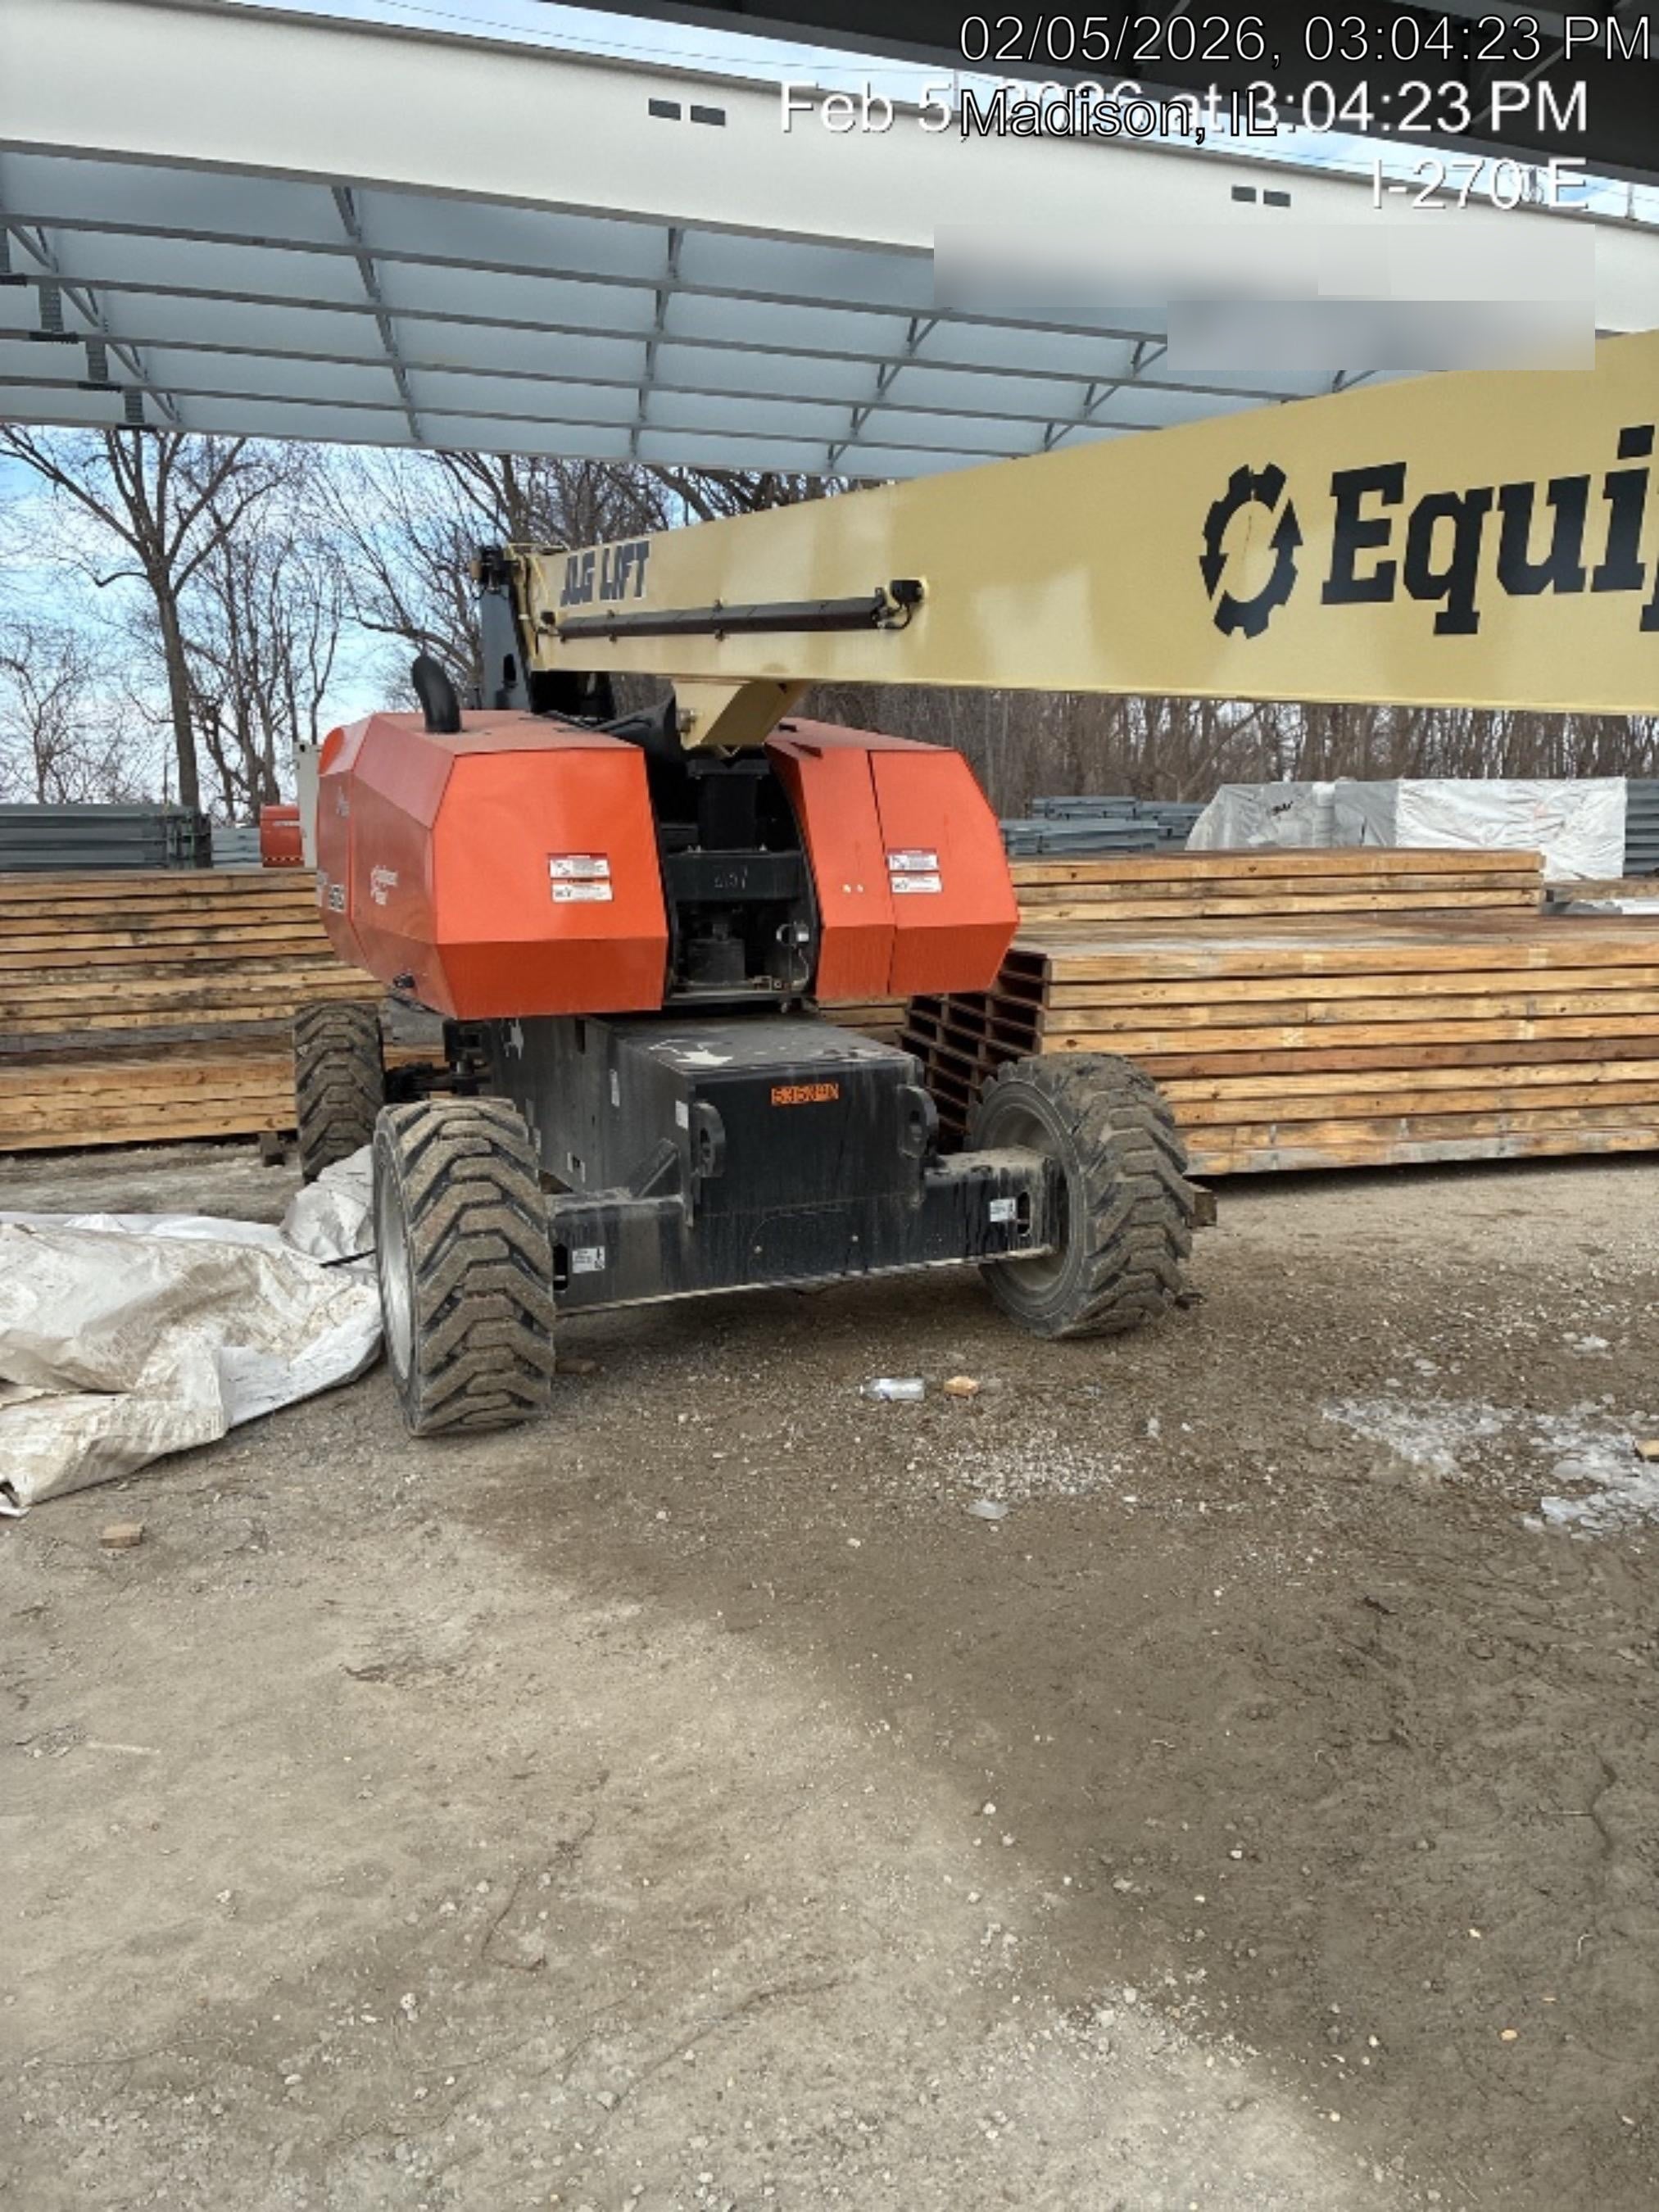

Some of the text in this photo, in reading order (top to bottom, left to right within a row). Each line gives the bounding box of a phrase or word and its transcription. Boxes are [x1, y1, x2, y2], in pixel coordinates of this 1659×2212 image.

[560, 541, 650, 607] JLG LIFT
[1321, 424, 1659, 635] Equi
